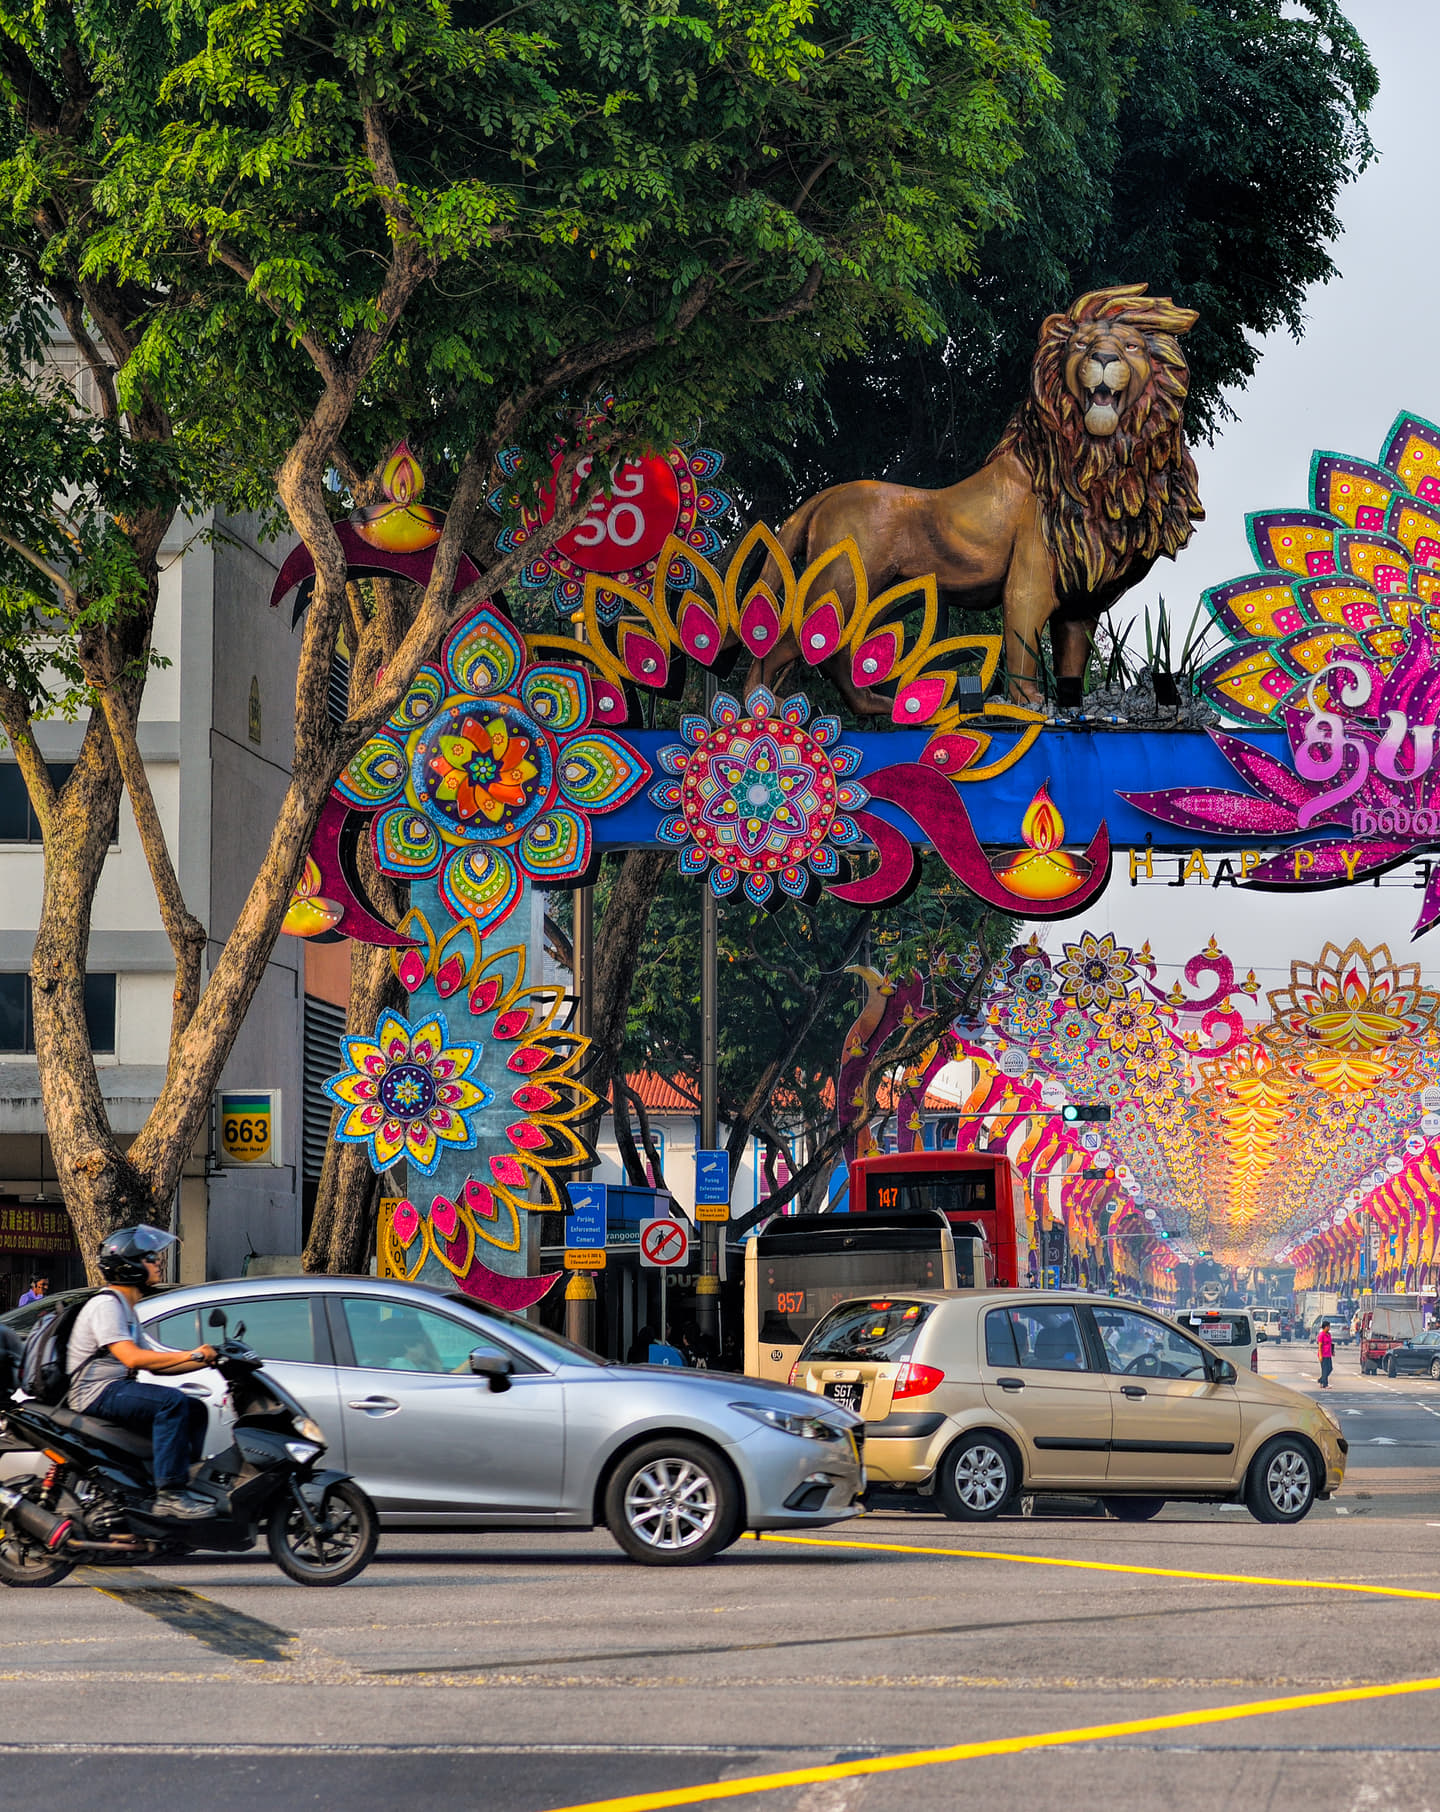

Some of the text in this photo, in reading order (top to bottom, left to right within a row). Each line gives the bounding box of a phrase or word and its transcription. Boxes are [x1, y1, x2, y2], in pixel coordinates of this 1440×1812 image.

[1128, 848, 1363, 880] HAPPY
[224, 1119, 268, 1142] 663
[878, 1188, 898, 1207] 147
[777, 1292, 804, 1313] 857
[834, 1384, 853, 1397] SGT
